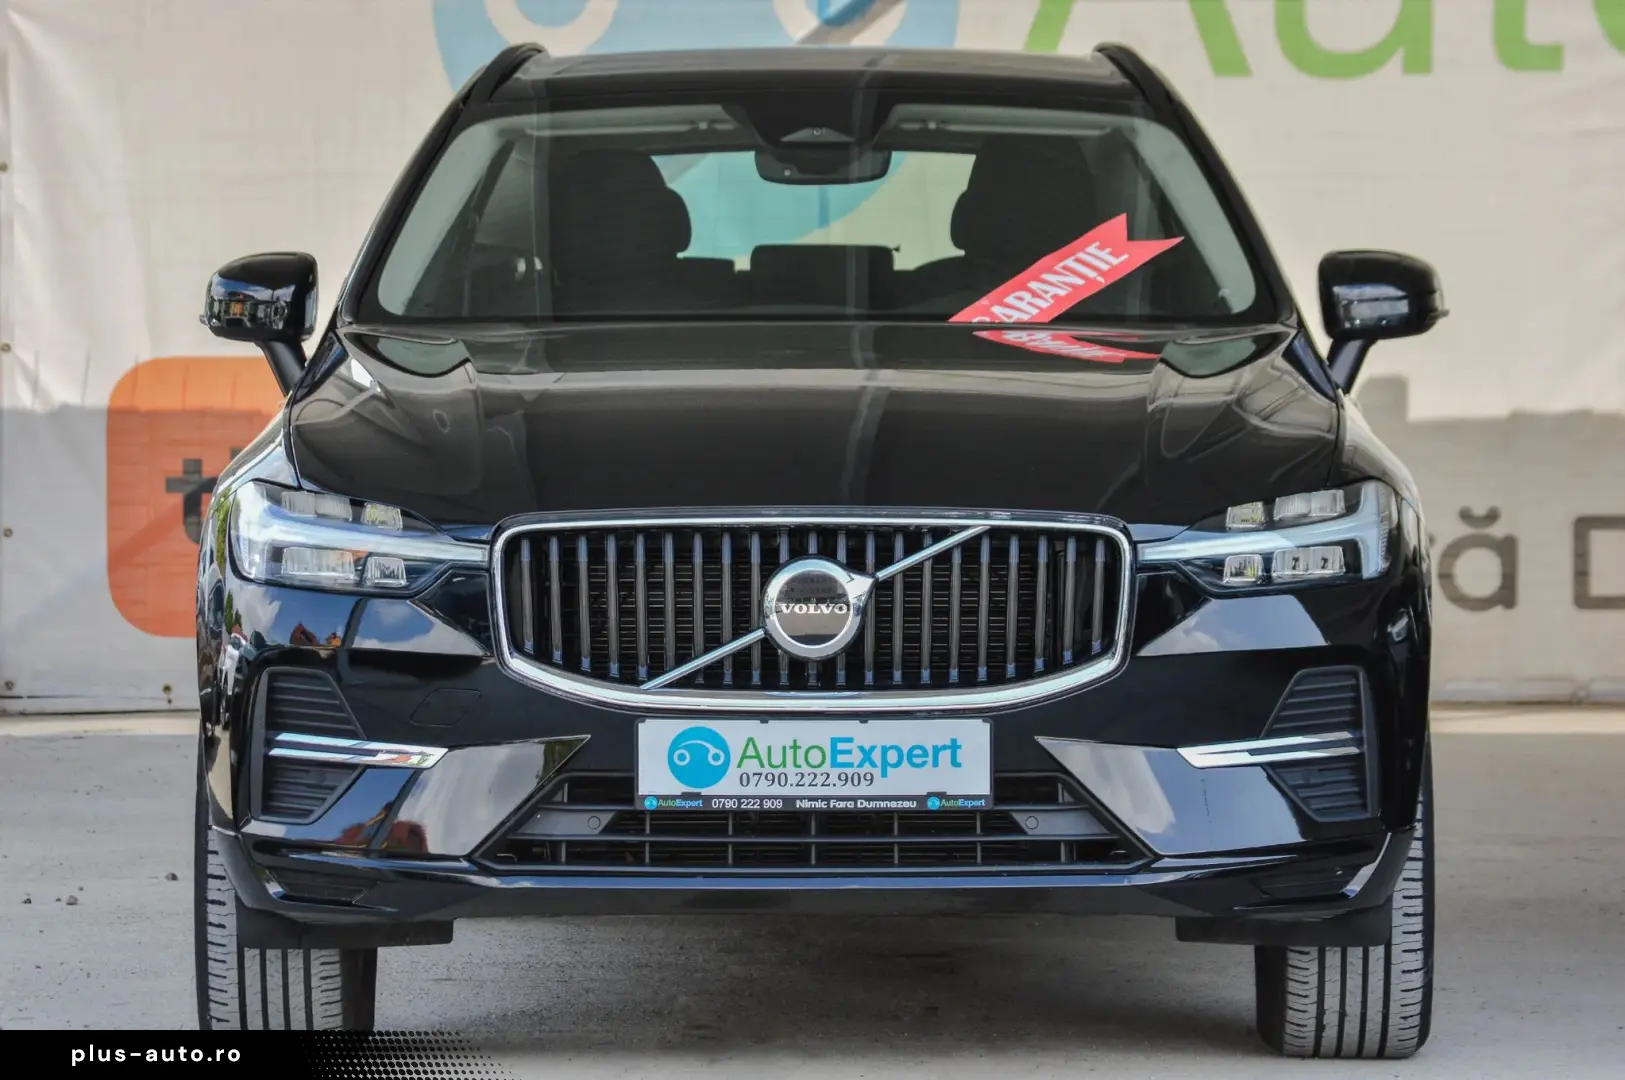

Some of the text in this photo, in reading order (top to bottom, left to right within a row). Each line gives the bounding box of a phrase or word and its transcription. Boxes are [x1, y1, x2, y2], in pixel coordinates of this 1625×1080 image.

[972, 241, 1130, 323] ARANȚIE
[780, 603, 848, 614] VOLVO
[737, 736, 962, 778] AutoExpert
[739, 771, 874, 788] 0790.222.909
[658, 798, 986, 809] AutoExpert 0790 222 909 Nimic Fara Dumnezeu AutoExpert
